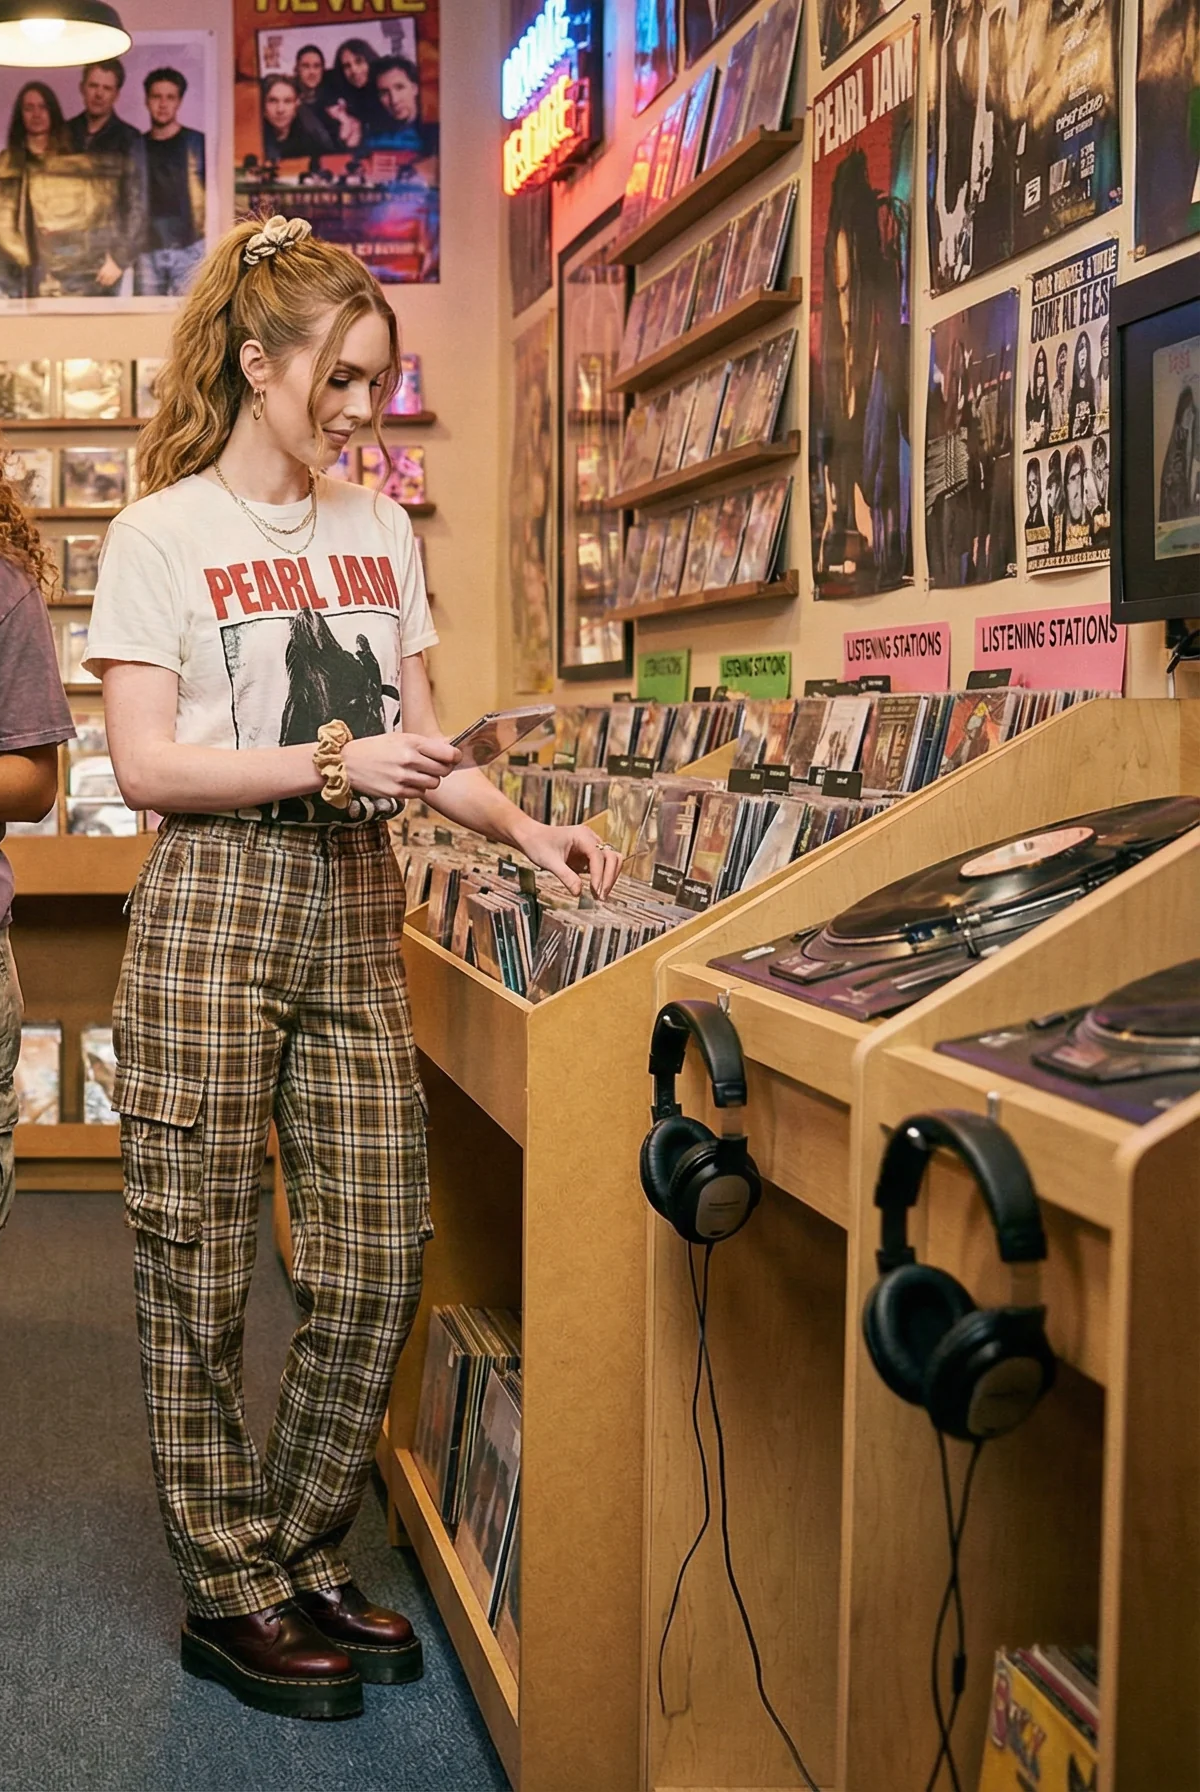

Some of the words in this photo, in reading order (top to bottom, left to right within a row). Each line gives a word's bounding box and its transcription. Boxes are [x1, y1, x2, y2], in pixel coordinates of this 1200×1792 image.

[814, 67, 868, 163] PEARL
[870, 30, 914, 123] JAM
[203, 557, 329, 621] PEARL
[328, 555, 400, 610] JAM
[847, 635, 891, 662] LISTENING
[893, 631, 942, 657] STATIONS
[982, 620, 1045, 653] LISTENING
[1049, 614, 1118, 648] STATIONS
